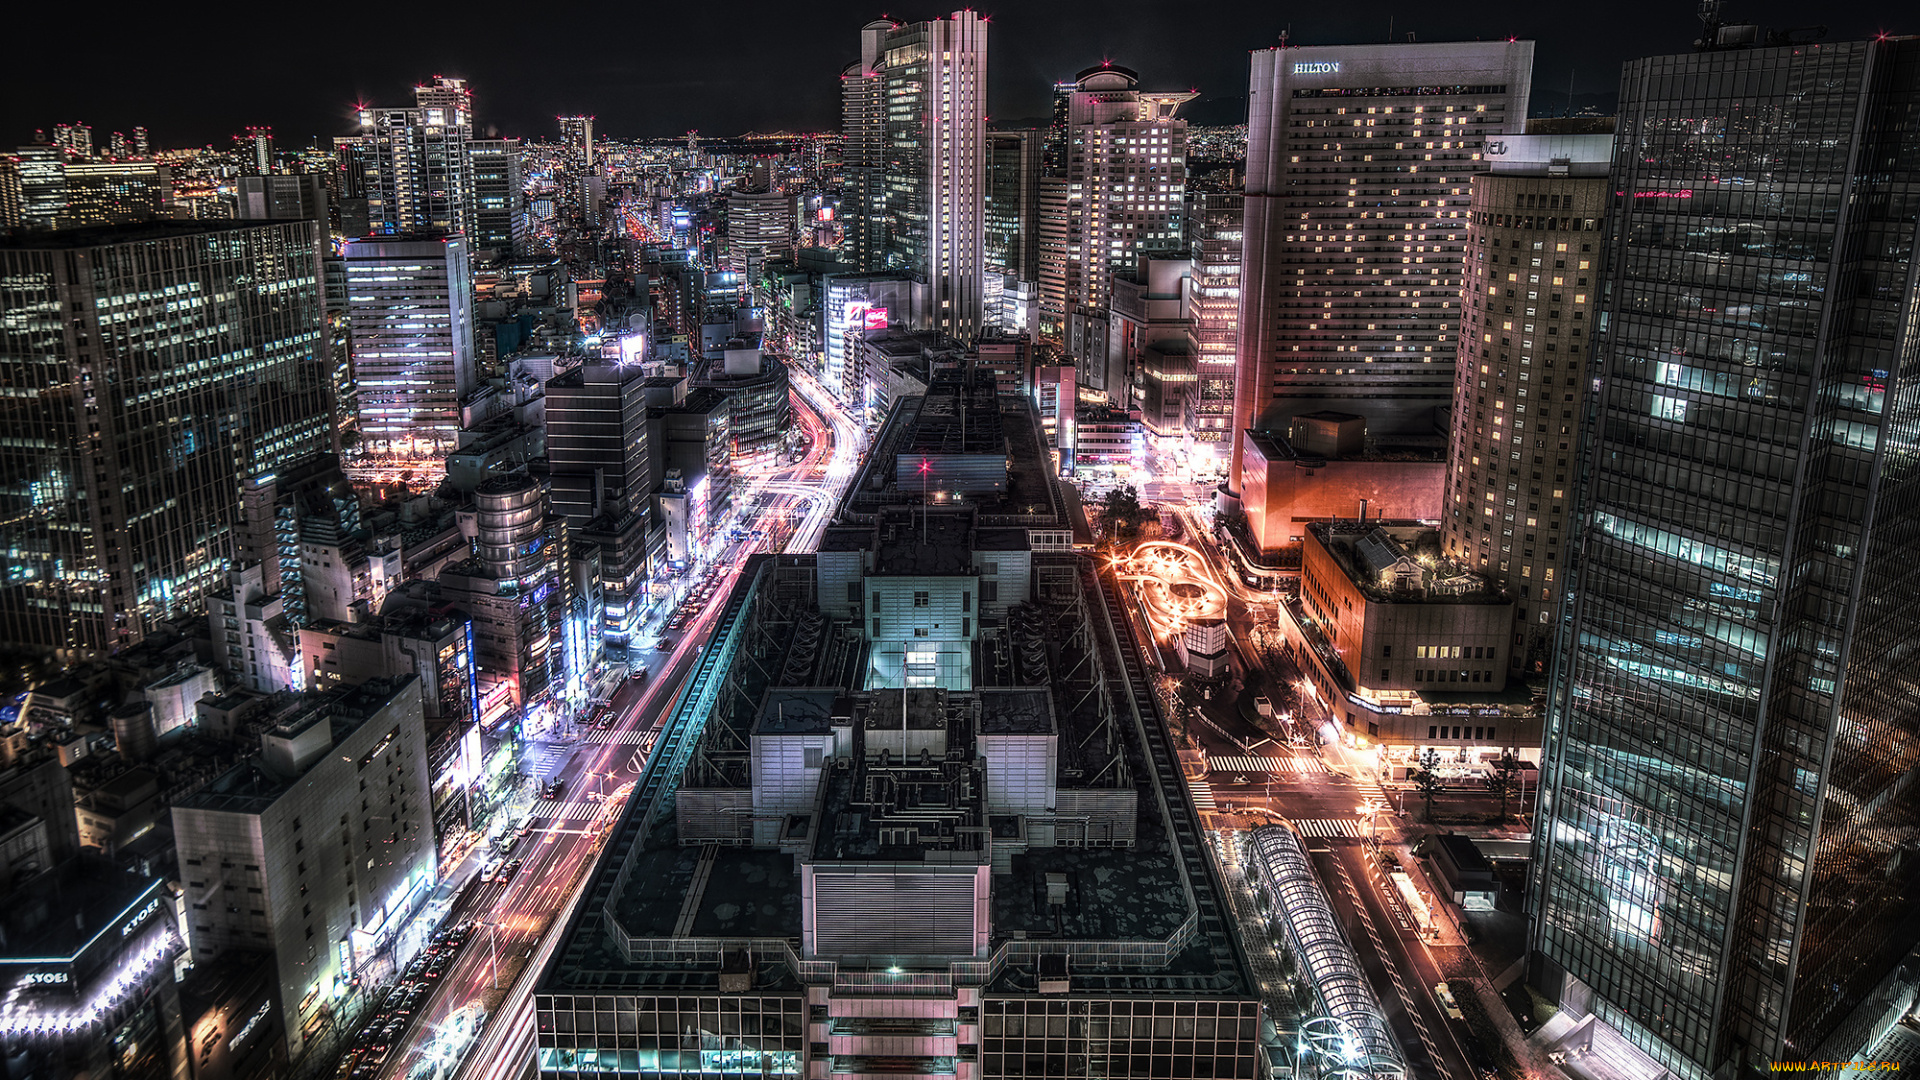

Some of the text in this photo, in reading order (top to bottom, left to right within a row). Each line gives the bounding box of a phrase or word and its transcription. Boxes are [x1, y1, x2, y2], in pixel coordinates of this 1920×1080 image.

[1294, 62, 1340, 74] HILTON
[122, 898, 159, 936] KYOEI
[24, 972, 69, 984] KYOEI
